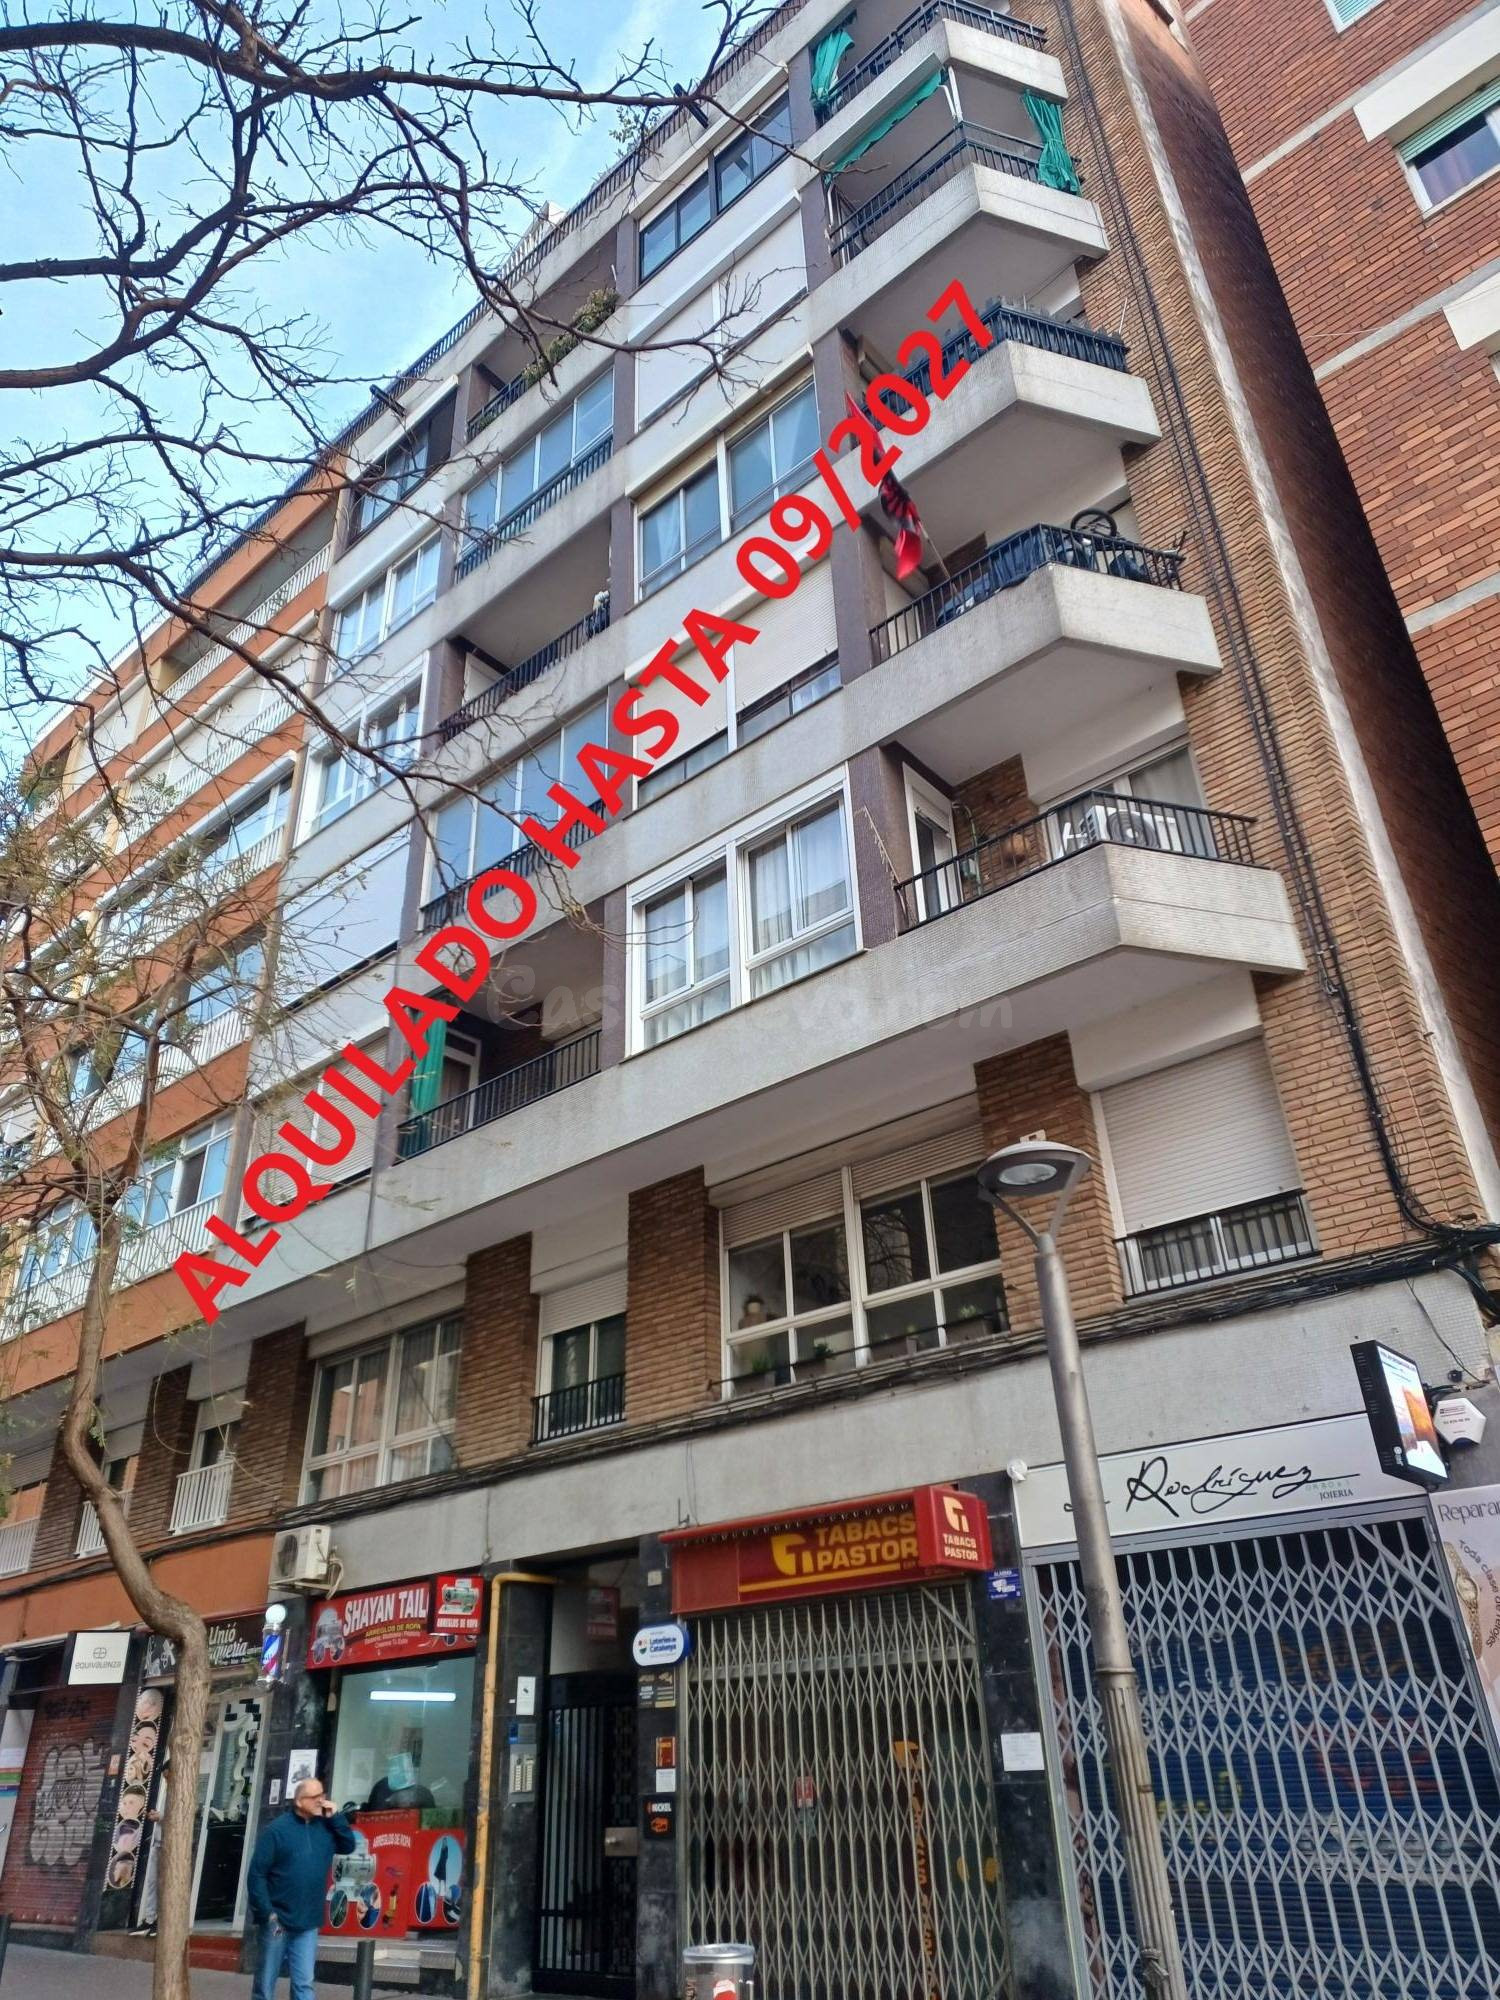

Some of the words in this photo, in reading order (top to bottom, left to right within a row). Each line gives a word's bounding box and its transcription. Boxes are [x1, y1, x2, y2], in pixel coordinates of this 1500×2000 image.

[1319, 1489, 1354, 1501] JOIERIA
[816, 1513, 916, 1548] TABACS
[1438, 1501, 1500, 1531] Repara
[817, 1536, 918, 1571] PASTOR
[942, 1533, 977, 1548] TABACS
[944, 1546, 979, 1561] PASTOR
[1459, 1539, 1482, 1564] Toda
[1480, 1563, 1499, 1593] clase
[342, 1593, 396, 1637] SHAYAN
[398, 1587, 430, 1620] TAIL
[396, 1624, 405, 1632] DE
